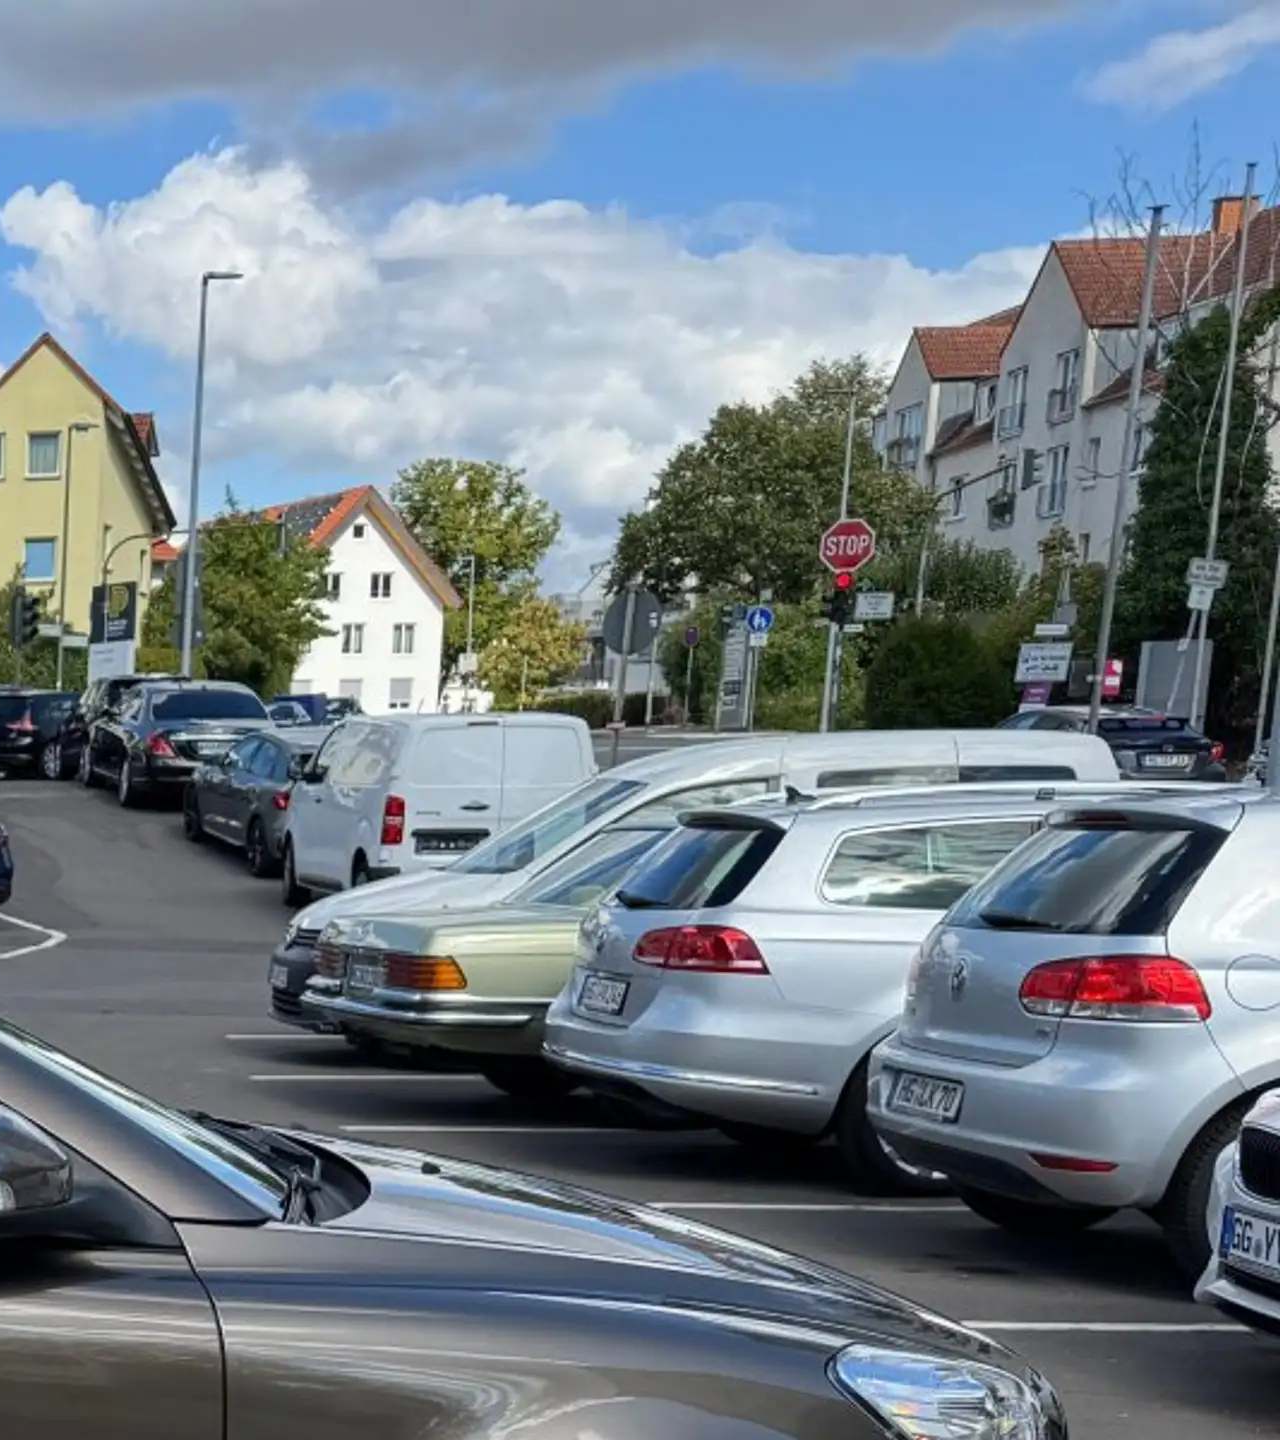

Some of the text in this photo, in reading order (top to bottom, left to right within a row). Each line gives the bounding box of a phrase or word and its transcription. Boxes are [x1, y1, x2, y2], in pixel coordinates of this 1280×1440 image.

[825, 534, 870, 556] STOP
[1232, 1216, 1280, 1264] GG Y
